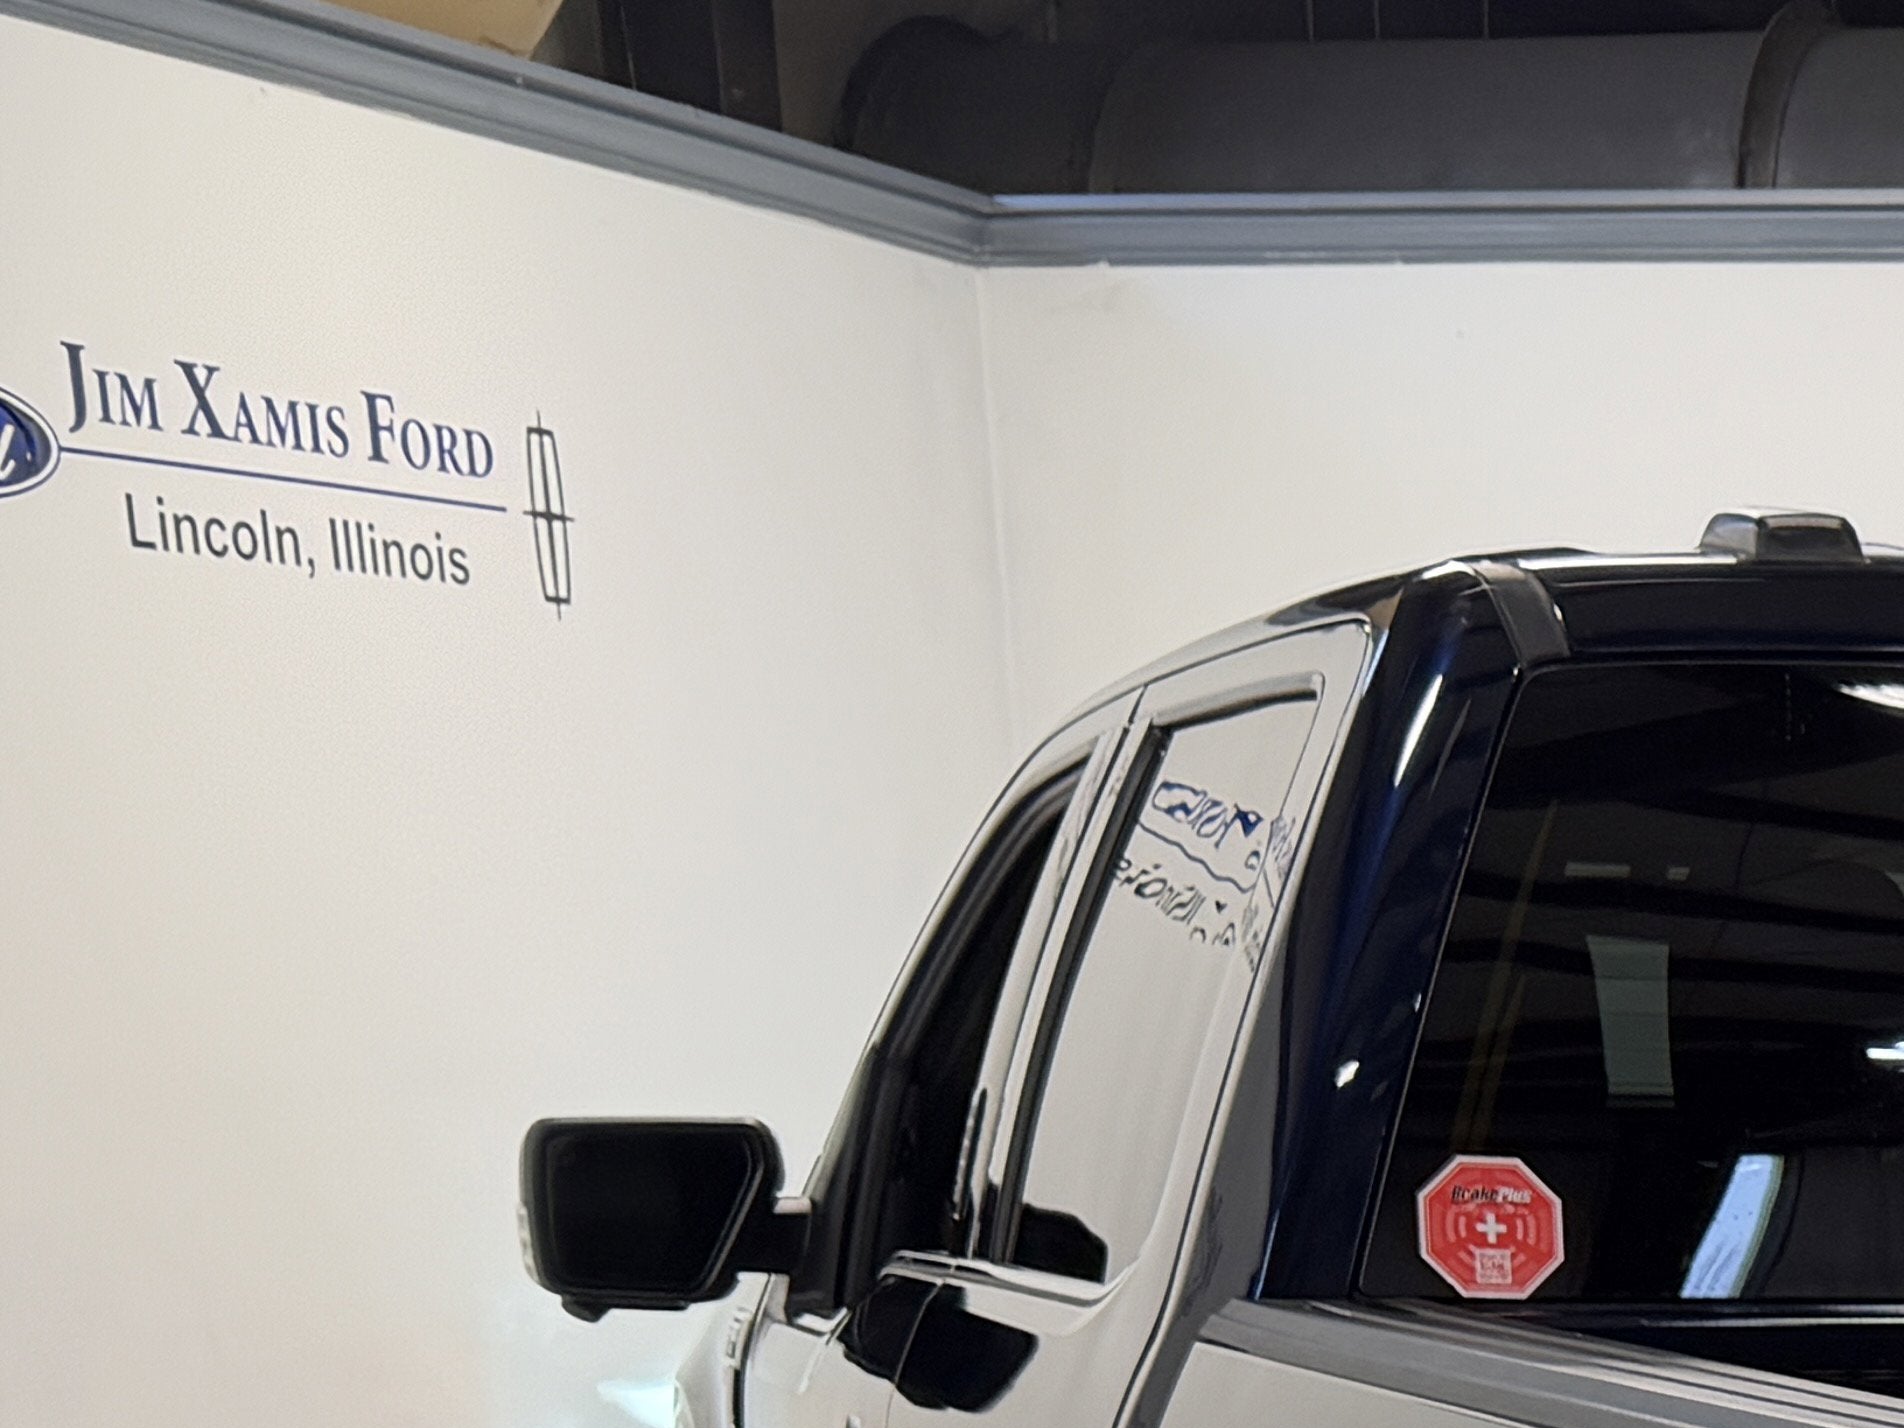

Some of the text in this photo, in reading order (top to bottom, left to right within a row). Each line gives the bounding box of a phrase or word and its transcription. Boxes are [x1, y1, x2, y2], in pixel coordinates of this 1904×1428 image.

[60, 340, 494, 479] JIM XAMIS FORD
[124, 492, 471, 586] Lincoln, Illinois
